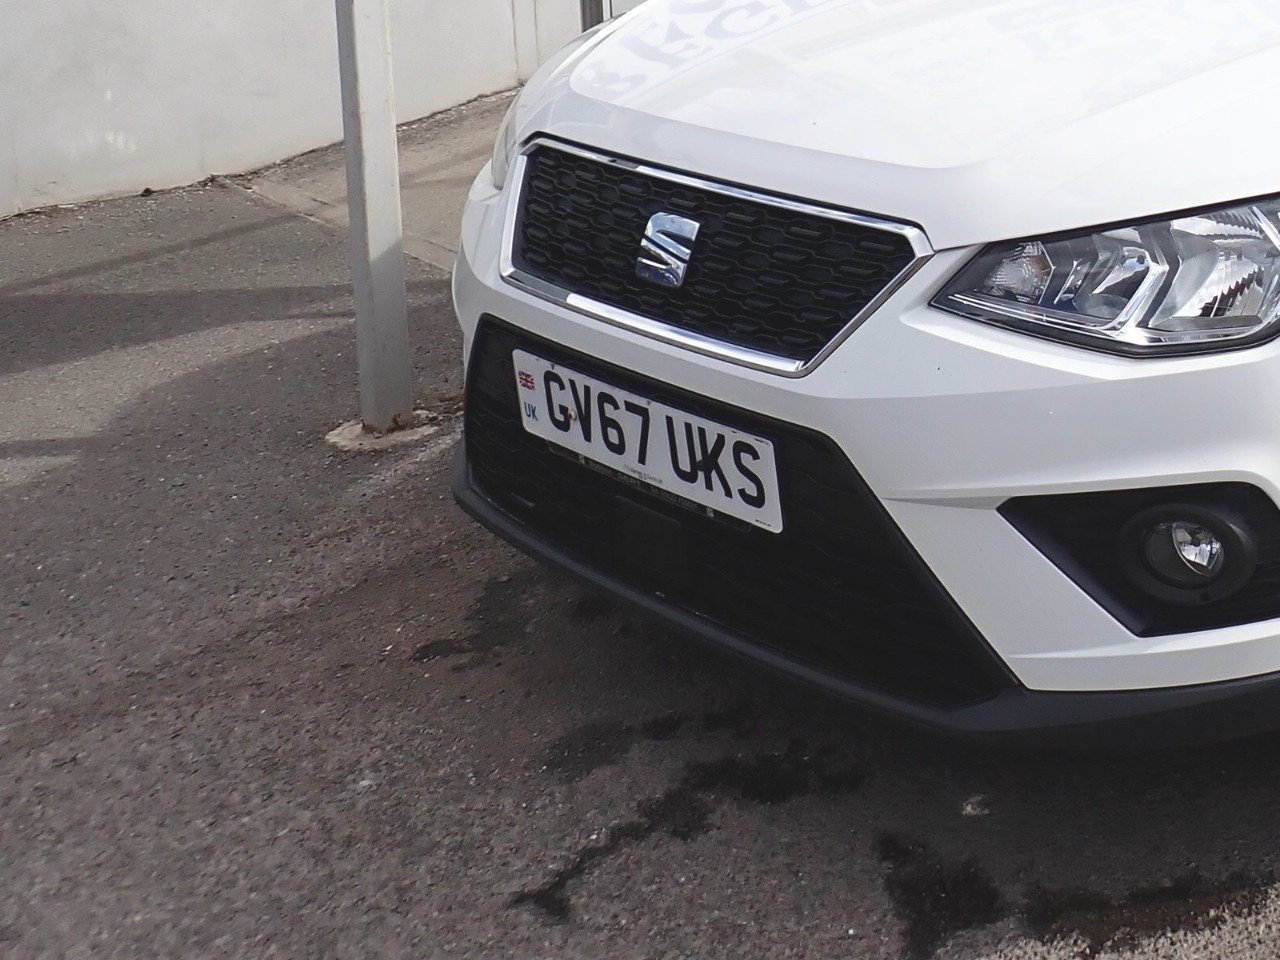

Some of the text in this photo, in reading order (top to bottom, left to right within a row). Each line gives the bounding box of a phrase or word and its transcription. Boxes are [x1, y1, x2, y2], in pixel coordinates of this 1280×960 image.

[523, 401, 538, 422] UK
[543, 369, 650, 466] GV67
[665, 414, 766, 509] UKS
